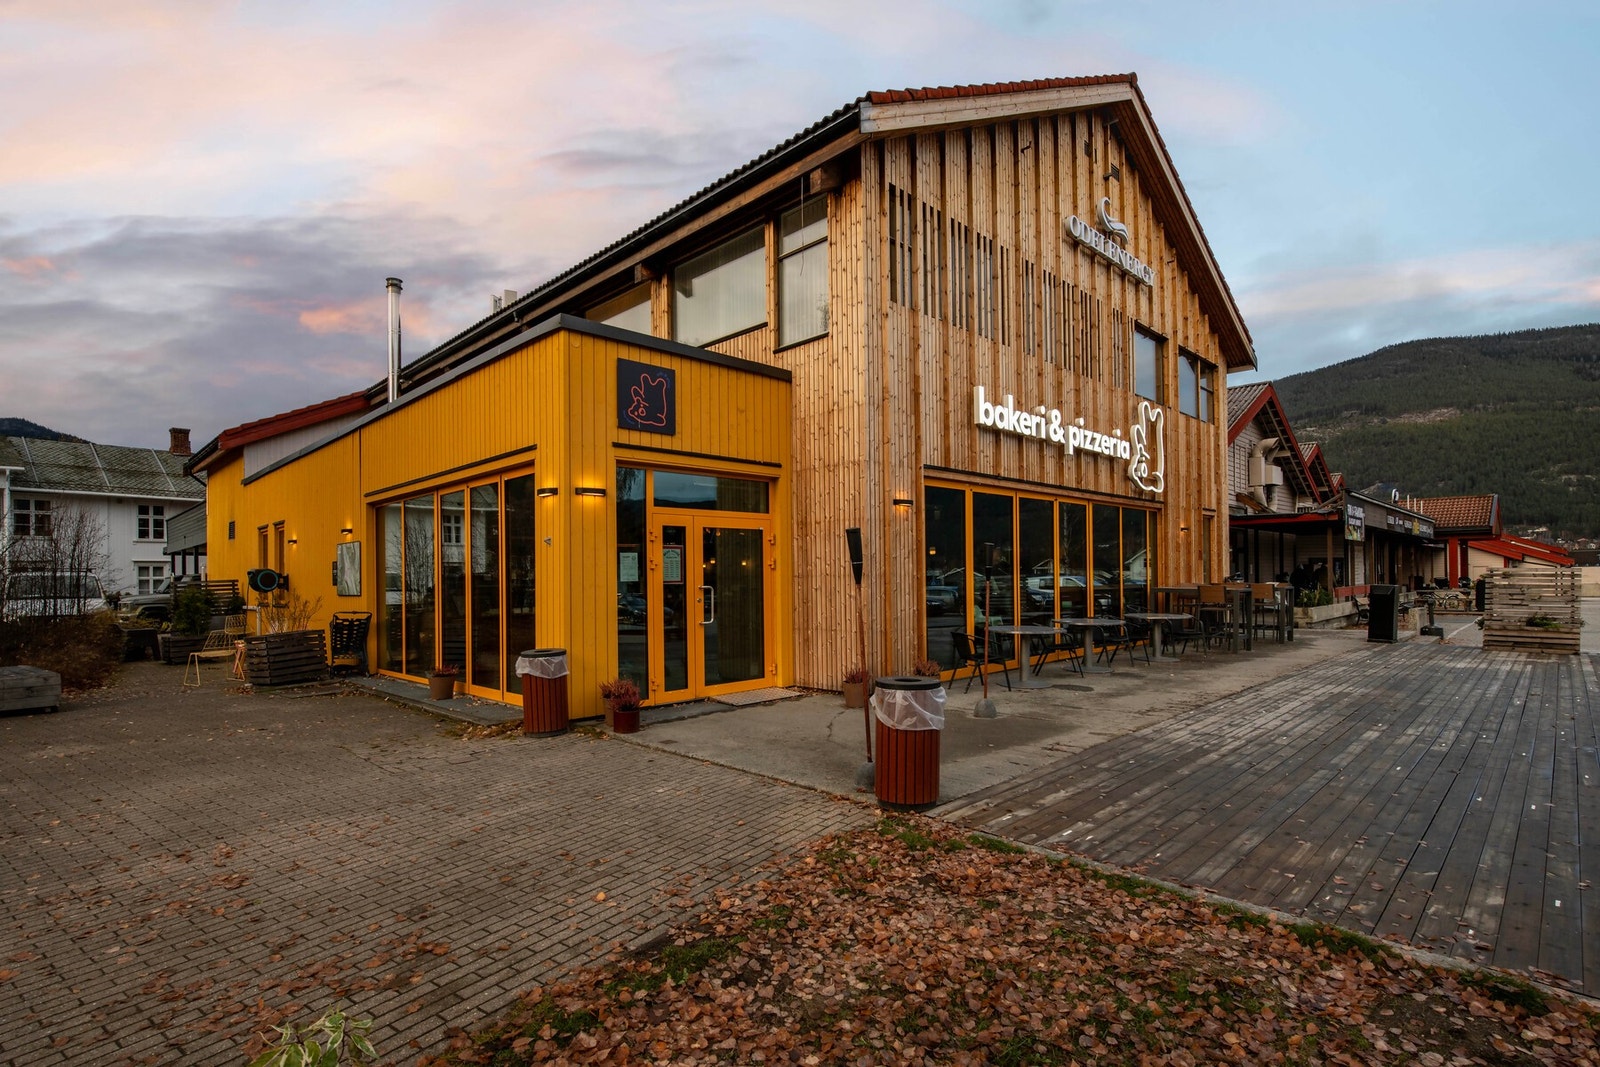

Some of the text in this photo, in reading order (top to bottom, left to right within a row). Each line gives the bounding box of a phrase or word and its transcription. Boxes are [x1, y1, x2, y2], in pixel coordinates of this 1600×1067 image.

[974, 385, 1131, 460] bakeri & pizzeria
